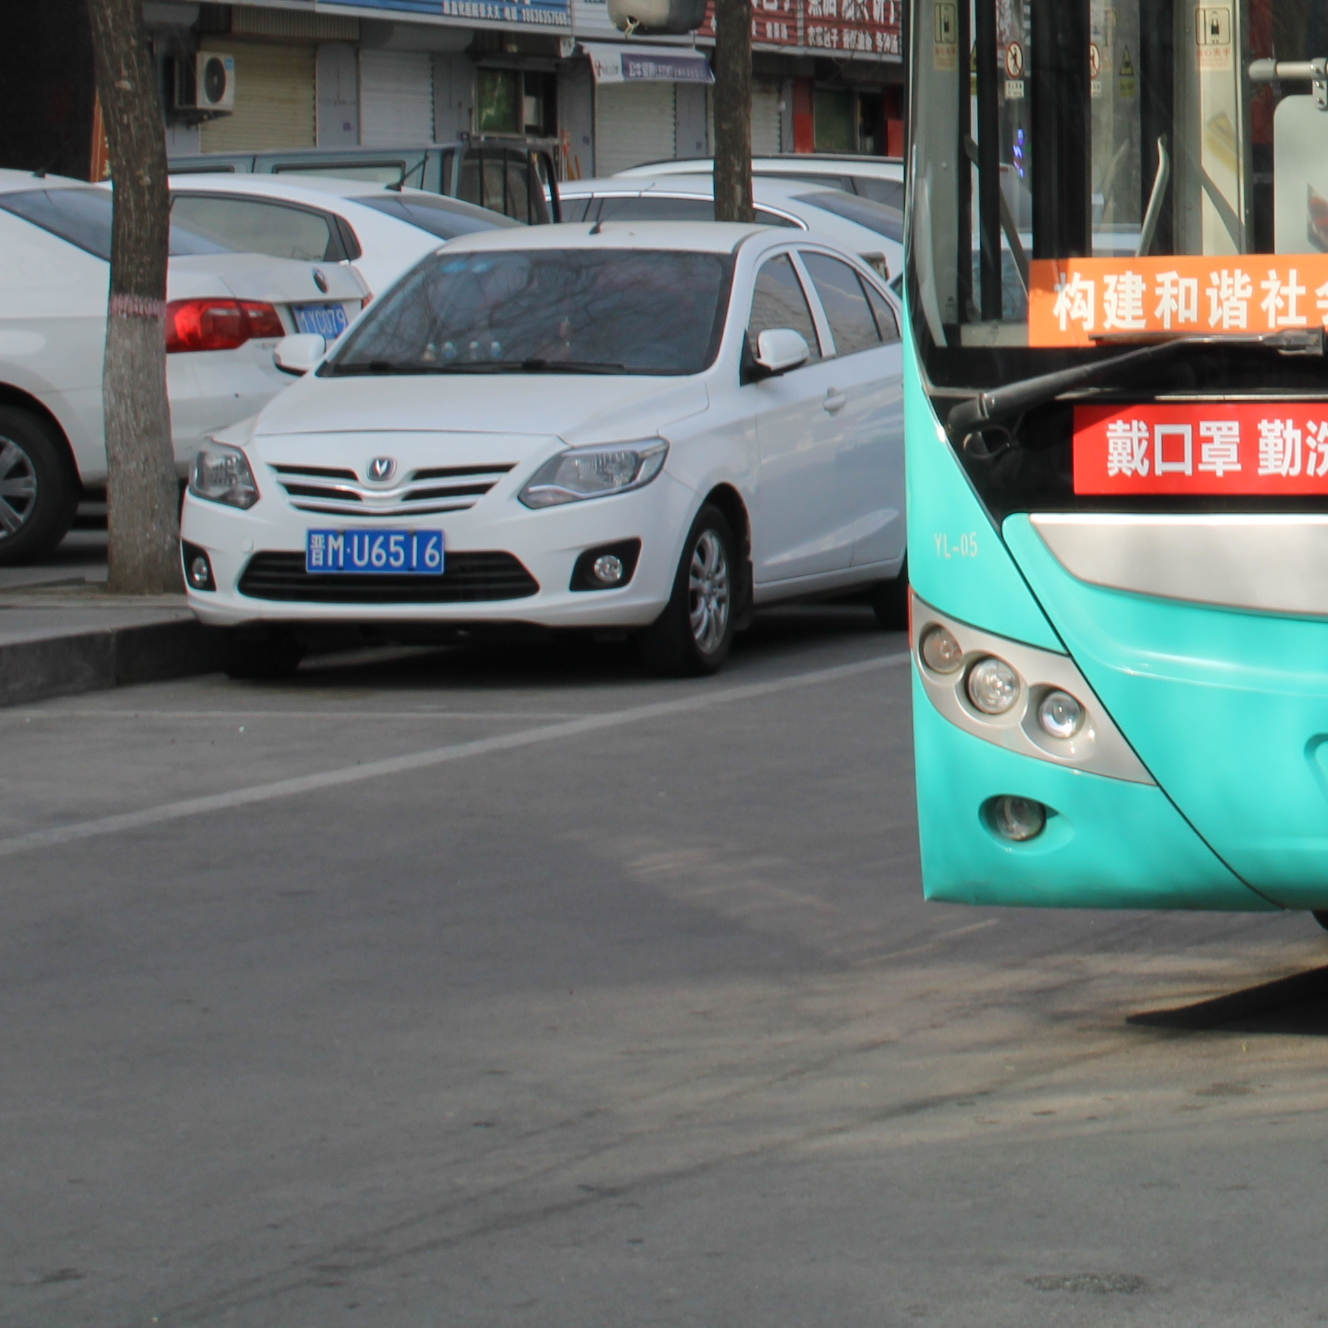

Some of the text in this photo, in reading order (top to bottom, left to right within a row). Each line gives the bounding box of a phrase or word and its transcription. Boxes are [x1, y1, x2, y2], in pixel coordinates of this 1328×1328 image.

[1106, 418, 1242, 478] 戴口罩
[934, 532, 978, 559] YL-05
